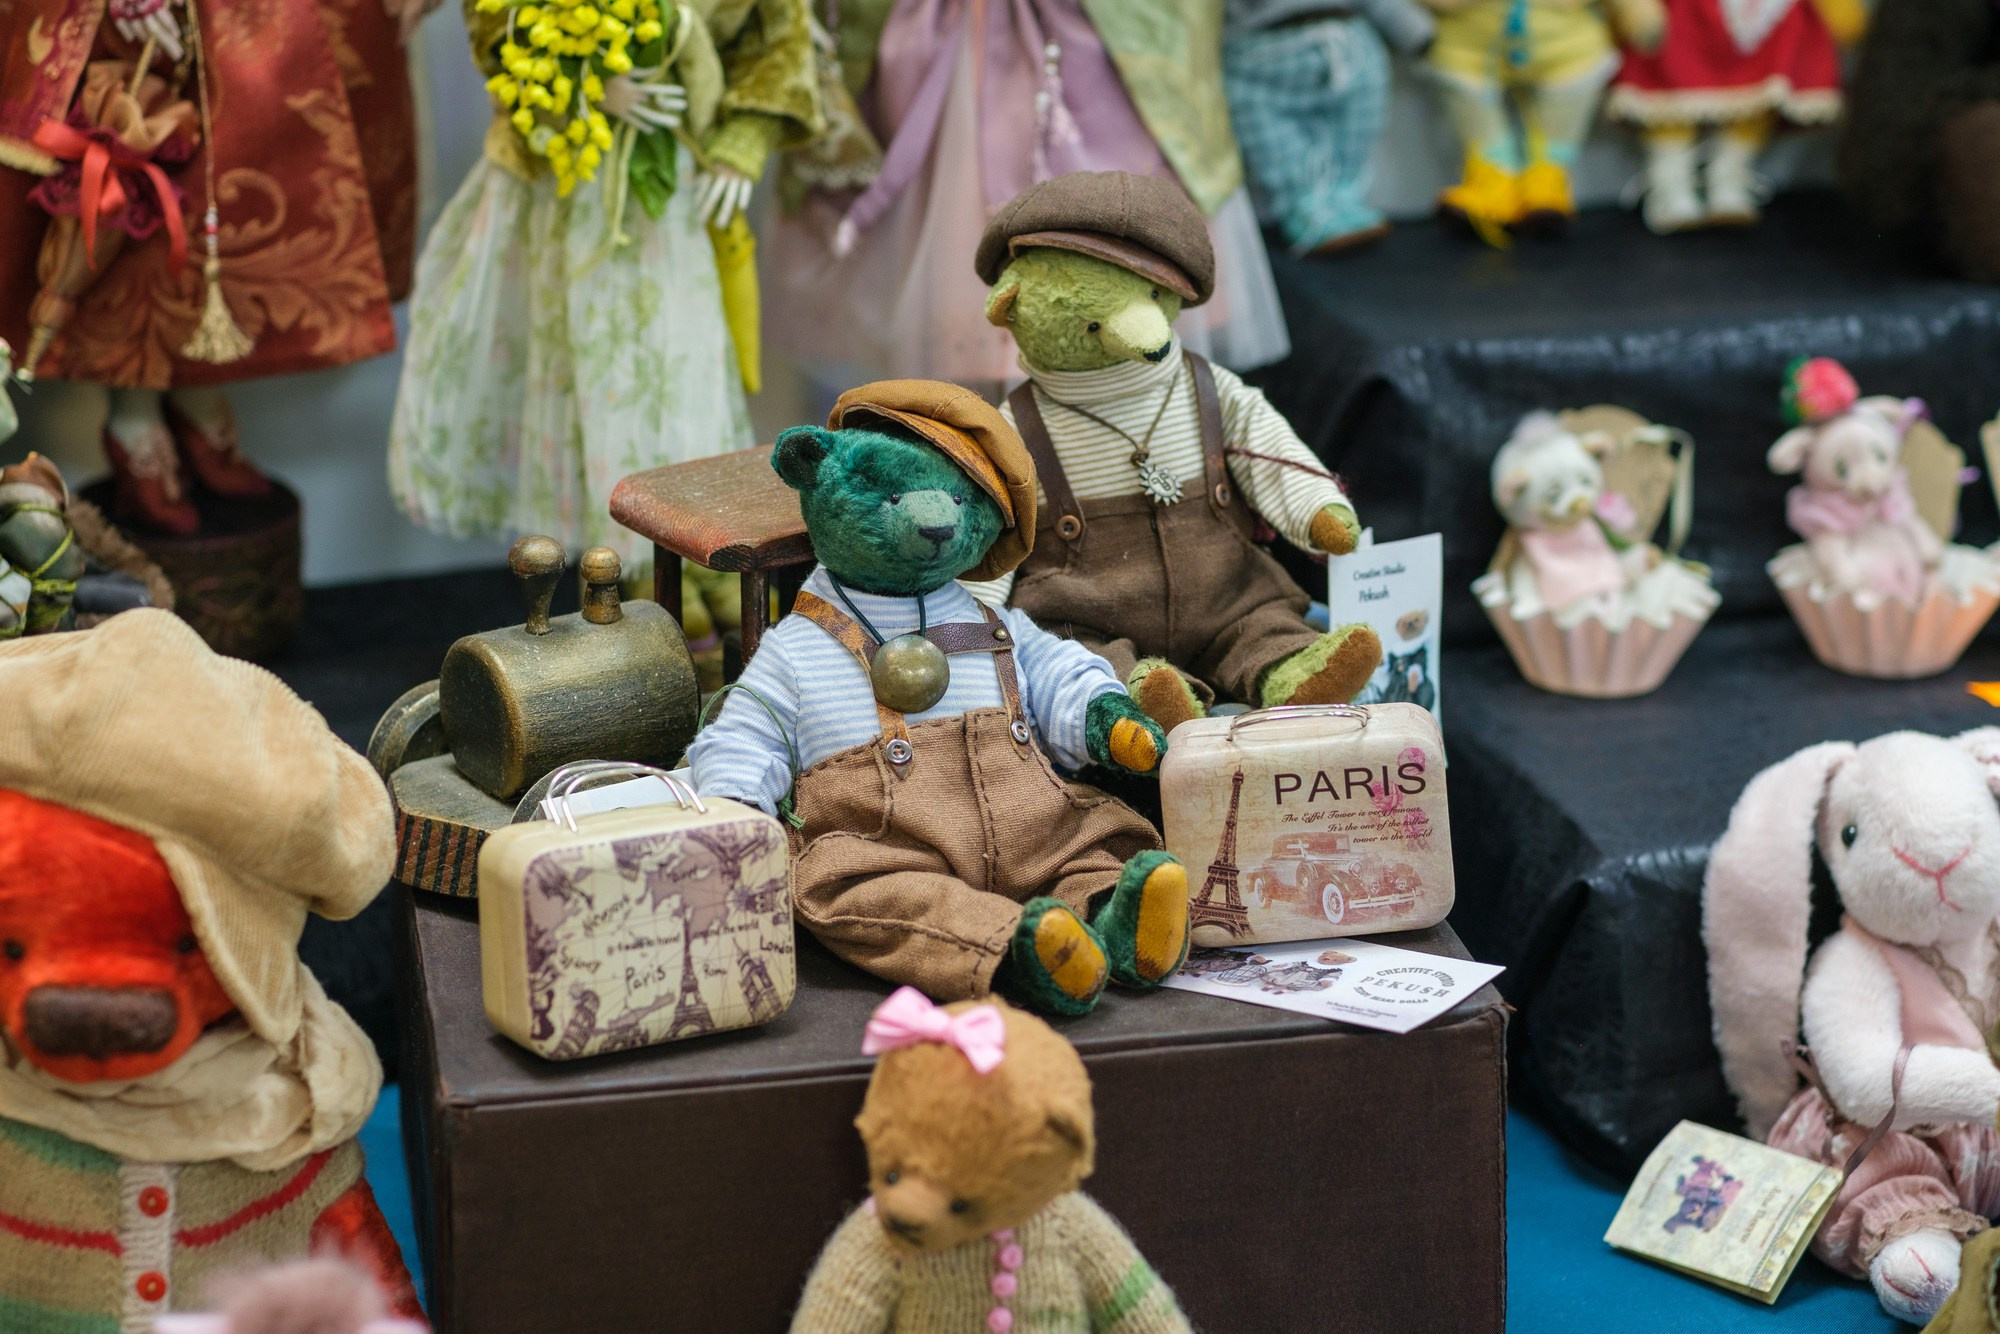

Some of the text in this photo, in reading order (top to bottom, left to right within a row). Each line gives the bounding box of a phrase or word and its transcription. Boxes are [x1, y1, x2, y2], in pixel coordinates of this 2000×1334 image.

[1274, 763, 1427, 805] PARIS
[1282, 814, 1299, 823] The
[1301, 811, 1325, 824] Eiffel
[1327, 810, 1356, 819] Tower
[1358, 809, 1367, 817] is
[1368, 809, 1387, 818] very
[1327, 823, 1343, 832] It's
[1345, 822, 1358, 831] the
[1377, 820, 1389, 831] of
[1388, 819, 1401, 828] the
[1403, 815, 1430, 826] tallest
[1353, 836, 1379, 844] tower
[1391, 832, 1403, 841] the
[1405, 828, 1433, 840] world
[760, 935, 793, 954] Londo
[625, 965, 666, 996] Paris
[1359, 976, 1451, 997] PEKUSH
[1376, 967, 1455, 987] CREATIVE STUDIO
